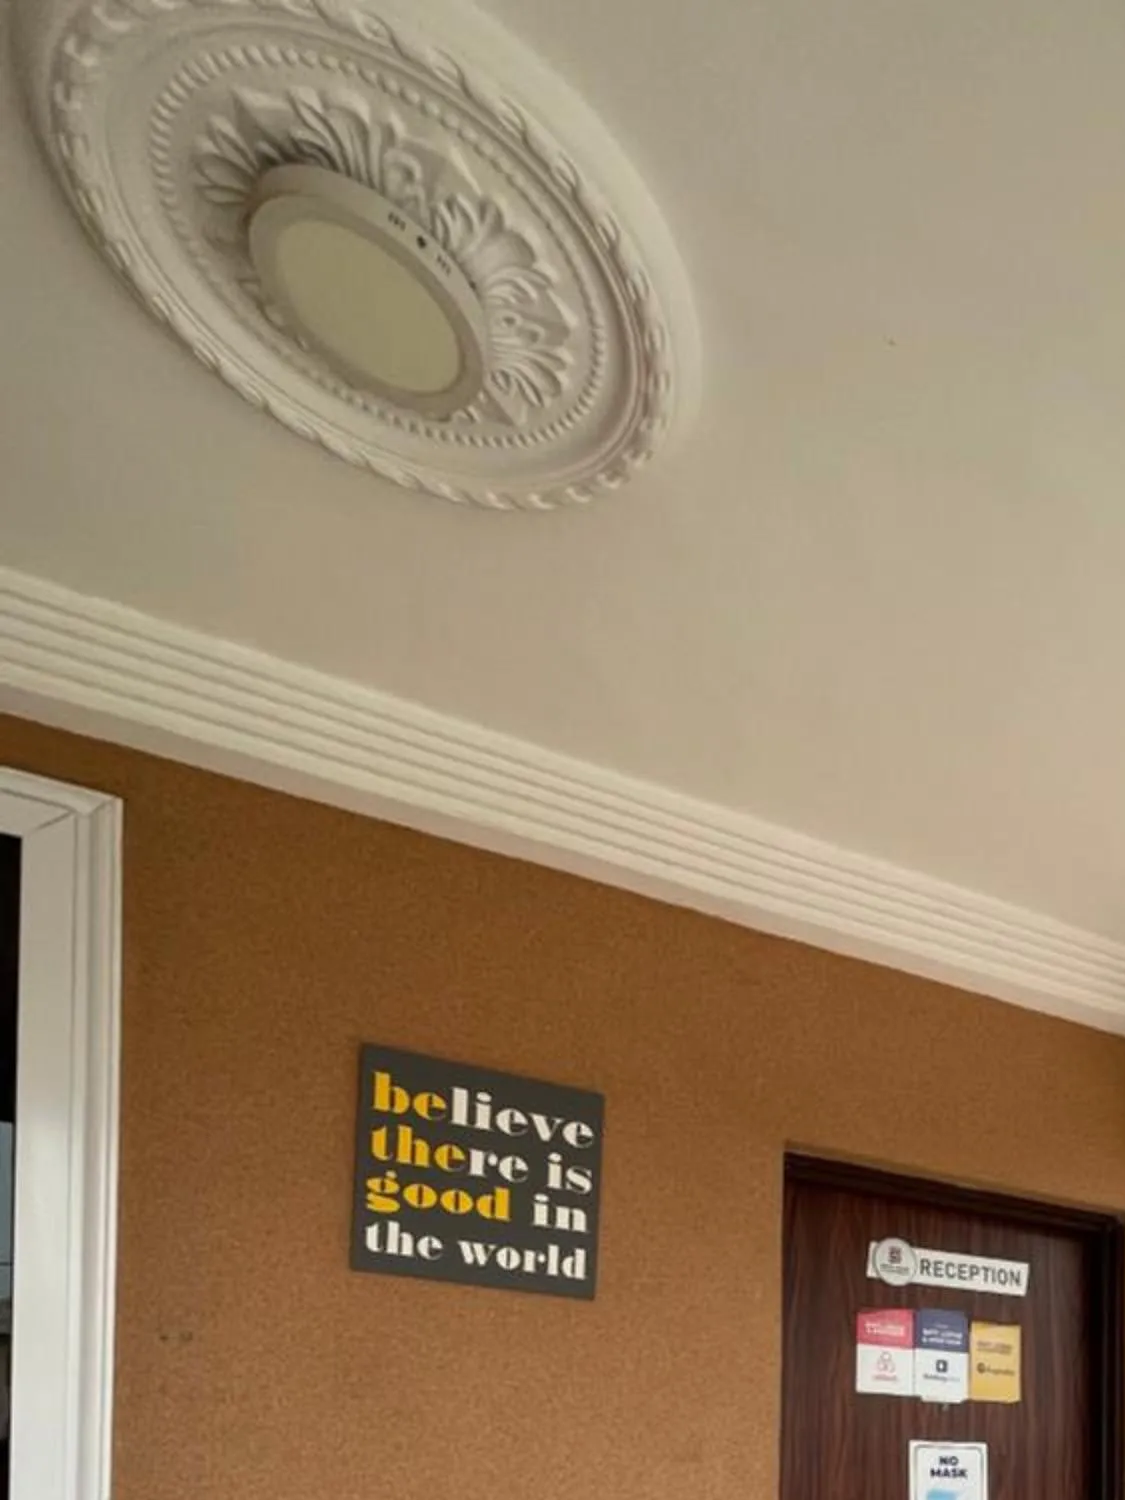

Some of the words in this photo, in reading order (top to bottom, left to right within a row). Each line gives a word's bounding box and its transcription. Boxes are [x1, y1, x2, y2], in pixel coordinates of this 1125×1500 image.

[373, 1071, 594, 1148] believe
[371, 1125, 529, 1183] there
[546, 1152, 593, 1195] is
[365, 1170, 511, 1222] good
[532, 1193, 589, 1233] in
[365, 1220, 444, 1260] the
[457, 1240, 586, 1280] world
[919, 1257, 1022, 1287] RECEPTION
[930, 1468, 968, 1479] MASK
[939, 1456, 960, 1467] NO
